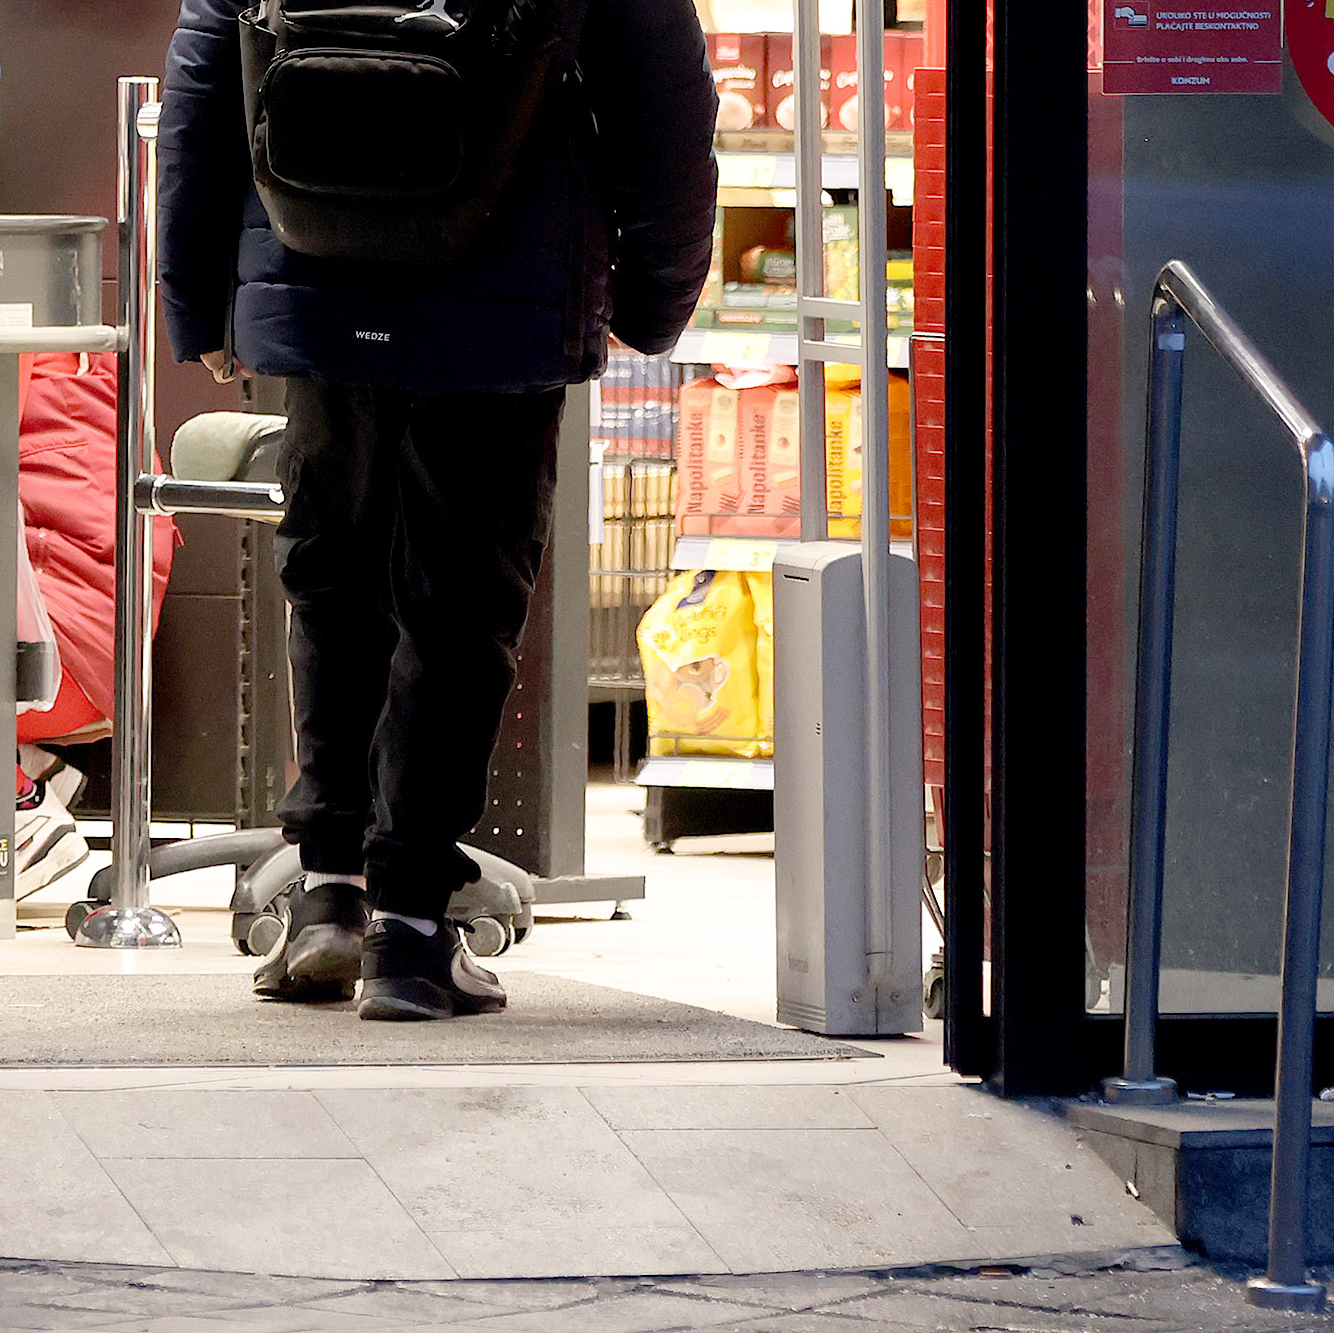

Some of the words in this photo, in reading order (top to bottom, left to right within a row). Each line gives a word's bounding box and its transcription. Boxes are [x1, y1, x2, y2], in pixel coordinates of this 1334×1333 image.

[1171, 77, 1211, 85] KONZUM
[356, 330, 391, 341] WEDZE
[686, 413, 708, 513] Napolitanke
[747, 414, 770, 515] Napolitanke
[827, 420, 848, 514] apolitanke
